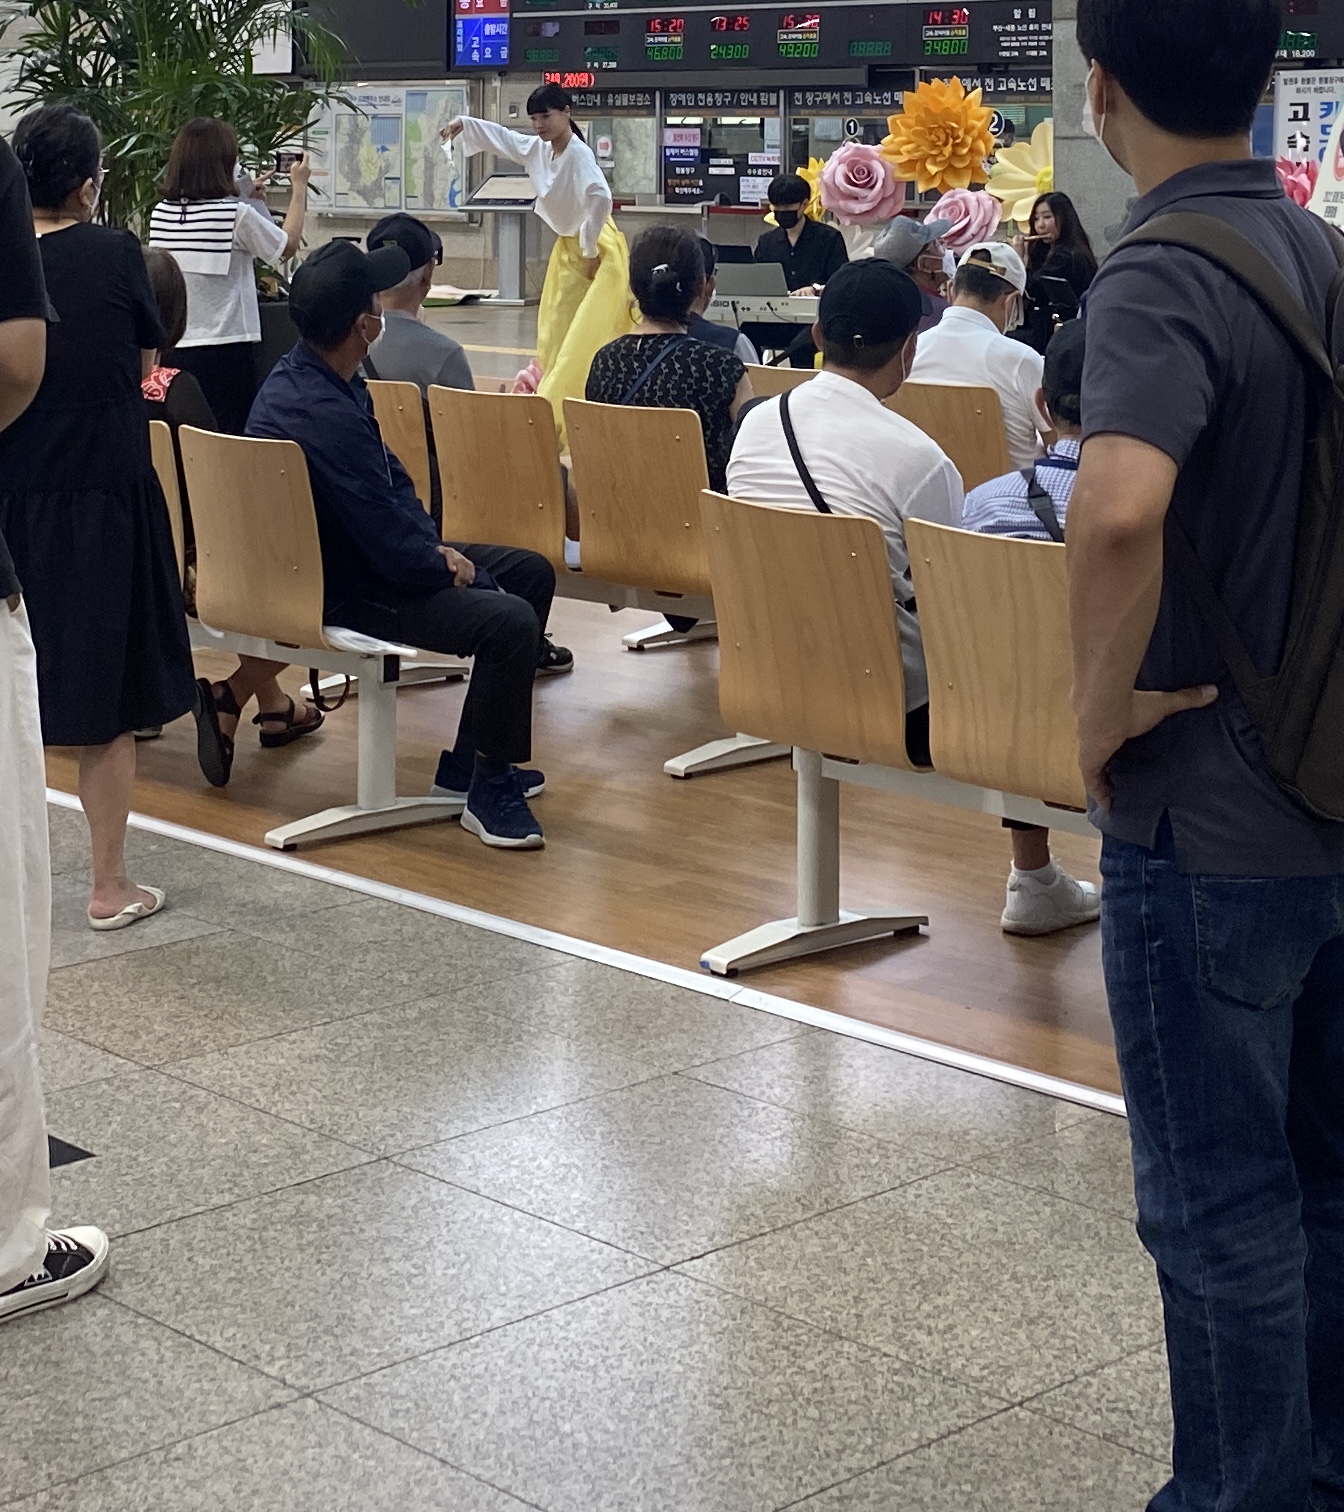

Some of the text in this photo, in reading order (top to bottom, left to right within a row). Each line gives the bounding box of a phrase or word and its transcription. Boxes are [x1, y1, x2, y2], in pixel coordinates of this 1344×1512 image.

[484, 23, 508, 36] 출발시간
[650, 18, 685, 32] 15:20
[985, 77, 1037, 91] 전 고속노선
[669, 91, 757, 107] 장애인 전용창구 안내
[794, 92, 892, 105] 전 창구에서 전 고속노선
